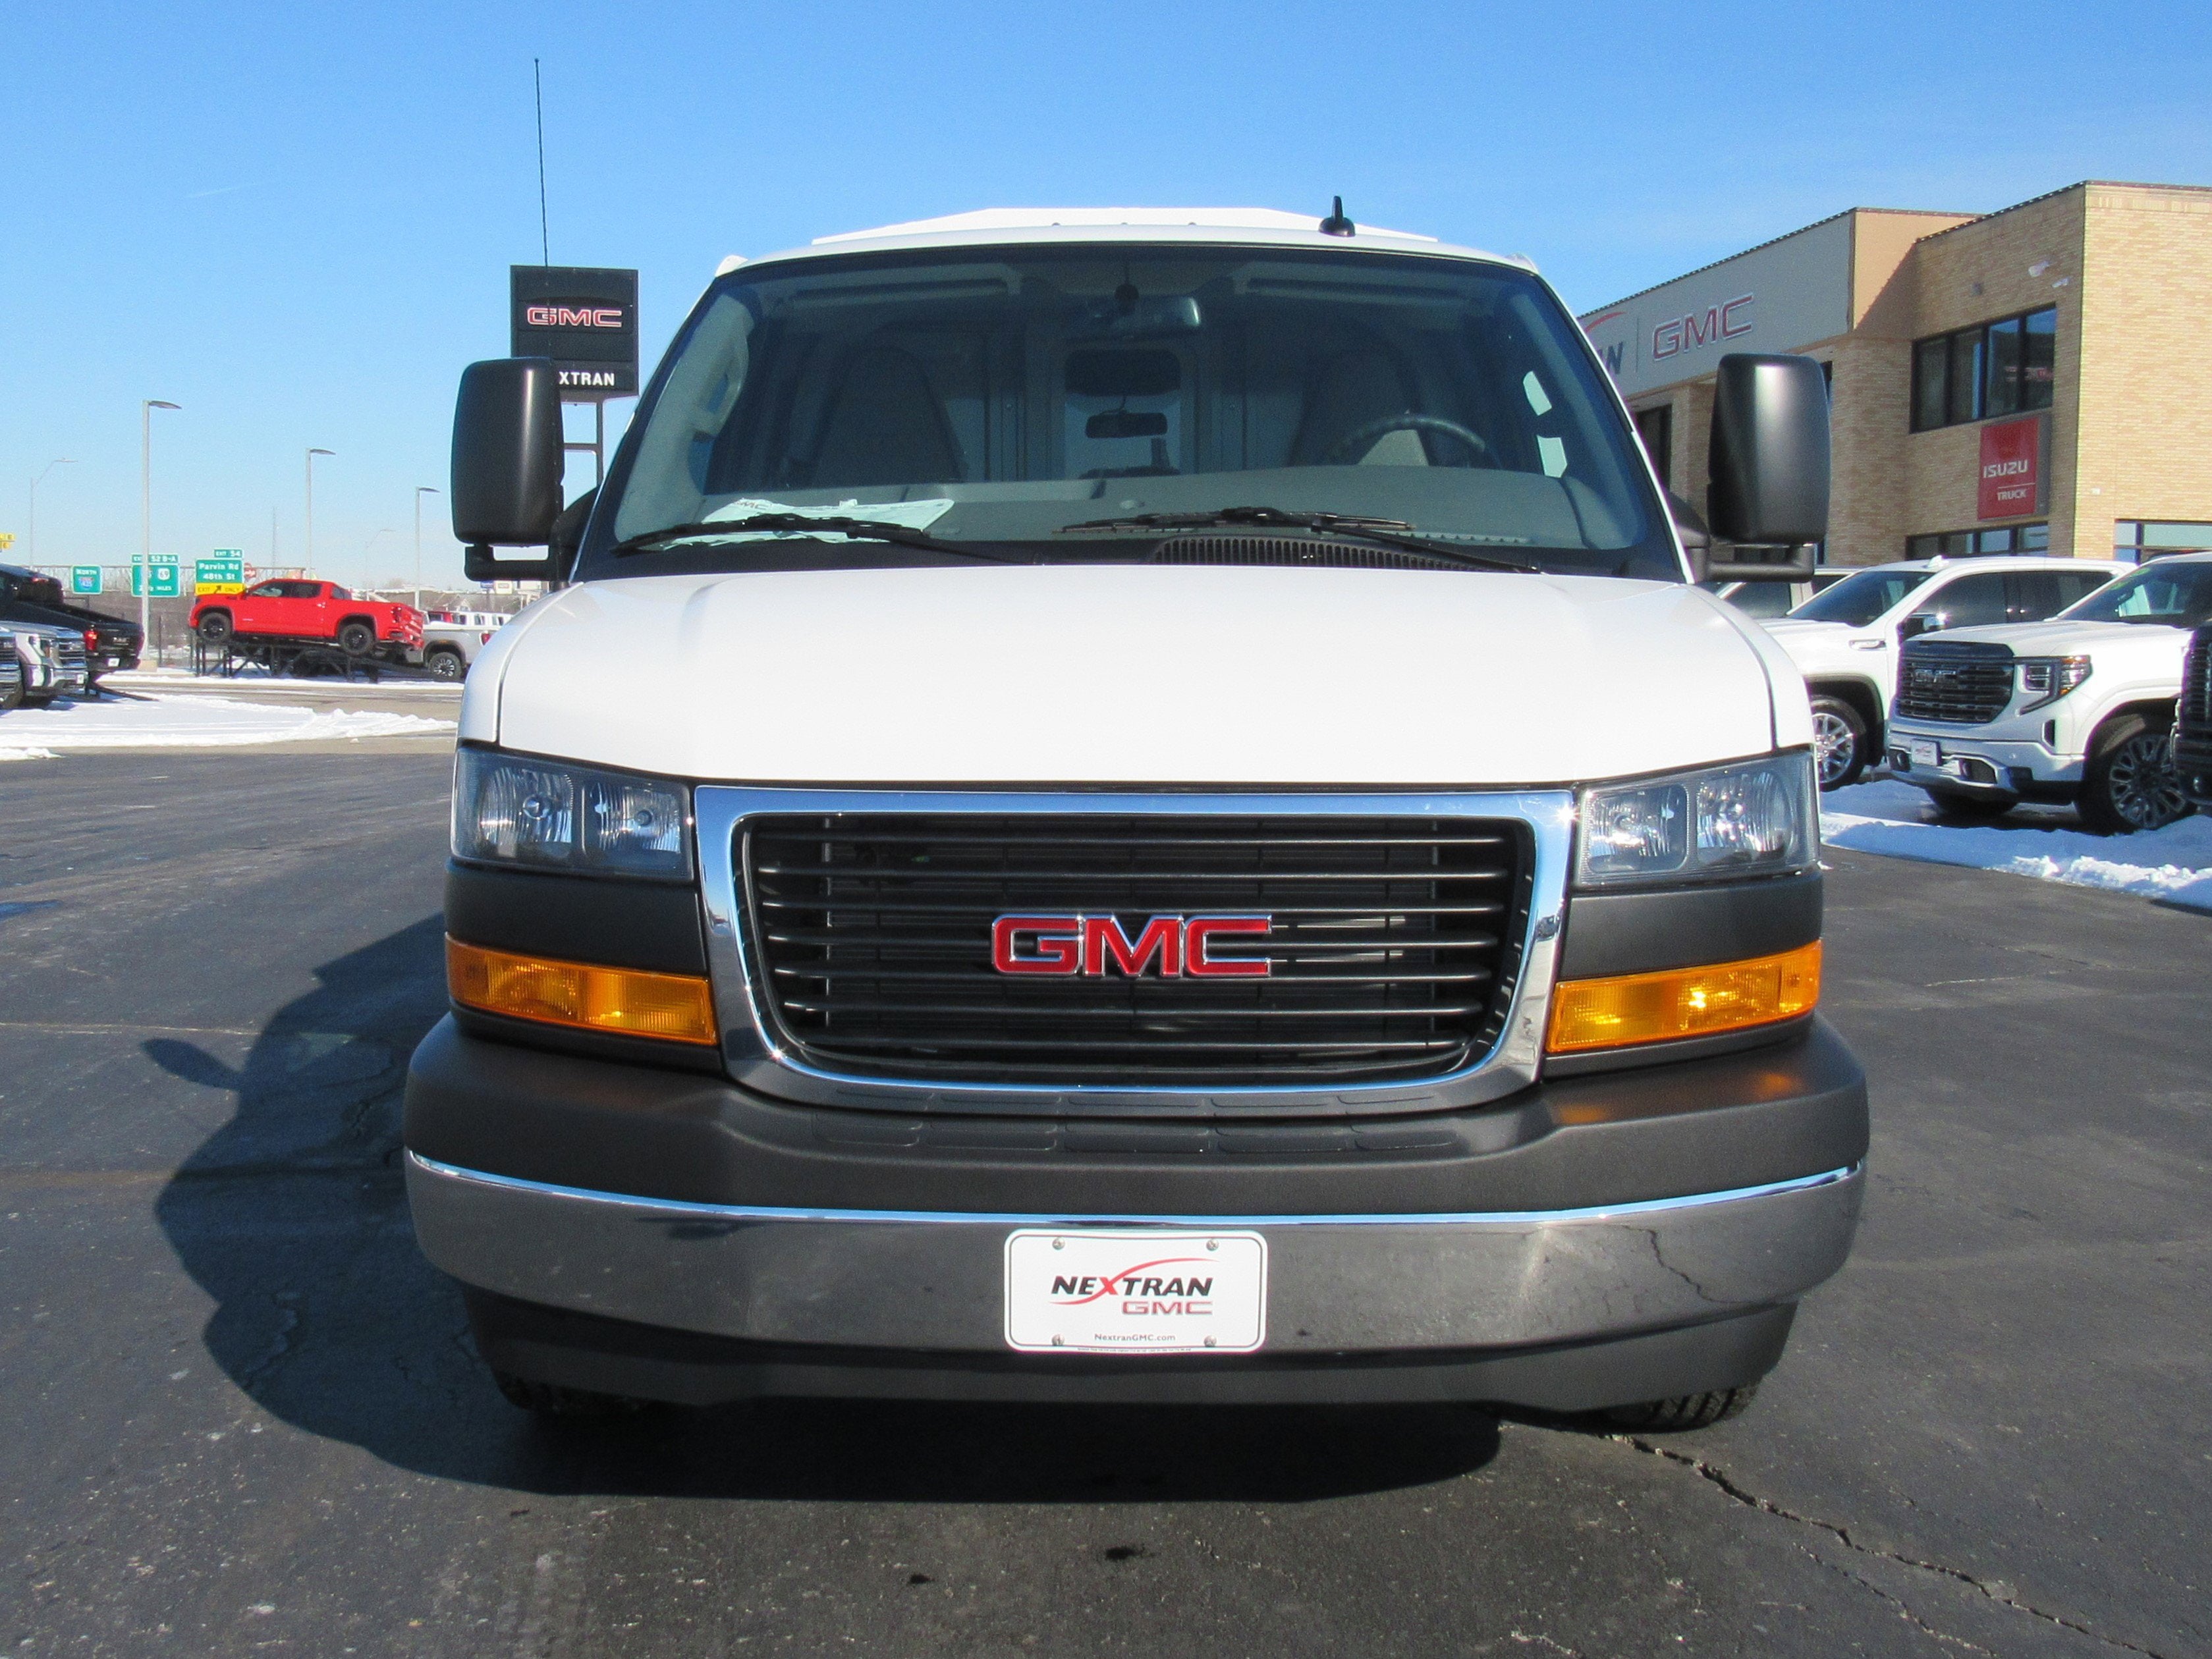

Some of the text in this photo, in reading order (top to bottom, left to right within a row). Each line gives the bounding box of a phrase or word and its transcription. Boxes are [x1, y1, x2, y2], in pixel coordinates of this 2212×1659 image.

[527, 307, 622, 327] GMC
[1653, 292, 1754, 361] GMC
[559, 371, 615, 386] XTRAN
[1983, 459, 2028, 478] ISUZU
[1997, 489, 2028, 501] TRUCK
[992, 913, 1272, 978] GMC
[1051, 1276, 1213, 1296] NEXTRAN
[1122, 1301, 1213, 1316] GMC
[1094, 1333, 1176, 1342] NextranGMC.com
